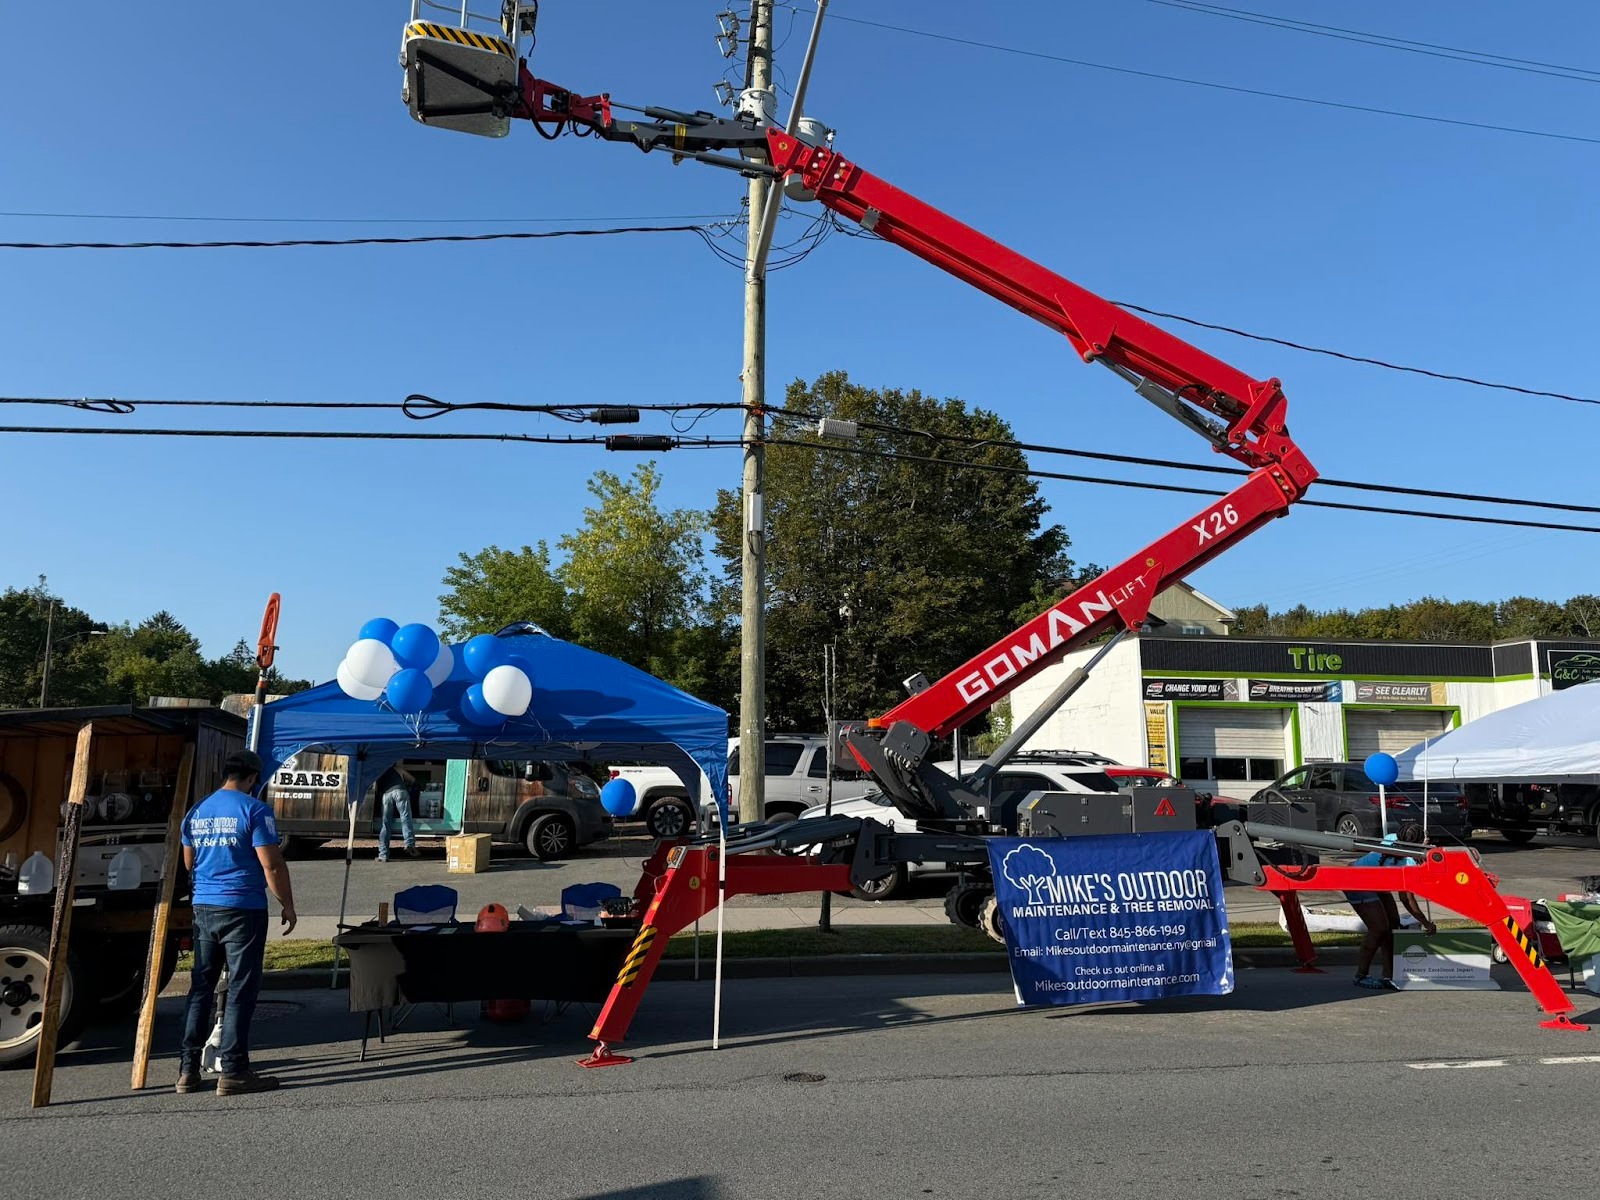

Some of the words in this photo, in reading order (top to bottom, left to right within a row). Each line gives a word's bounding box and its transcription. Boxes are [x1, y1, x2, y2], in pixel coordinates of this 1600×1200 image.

[1192, 503, 1239, 546] X26
[955, 590, 1114, 705] GOMAN
[1110, 575, 1147, 606] LIFT
[1287, 647, 1343, 671] Tire
[1554, 668, 1580, 680] G&C
[1165, 684, 1190, 692] CHANGE
[1191, 684, 1207, 692] YOUR
[1268, 685, 1294, 693] BREATHE
[1375, 686, 1390, 695] SEE
[1392, 686, 1428, 696] CLEARLY!
[280, 772, 340, 787] BARS
[1046, 872, 1115, 904] MIKE'S
[1118, 869, 1209, 901] OUTDOOR
[1013, 903, 1108, 918] MAINTENANCE
[1110, 903, 1120, 914] &
[1122, 901, 1155, 913] TREE
[1157, 899, 1214, 912] REMOVAL
[1055, 926, 1107, 941] Call/Text
[1109, 924, 1186, 939] 845-866-1949
[1014, 946, 1043, 957] Email:
[1046, 937, 1217, 956] Mikesoutdoormaintenance.ny@gmail
[1075, 966, 1100, 976] Check
[1103, 967, 1112, 975] us
[1114, 965, 1128, 974] out
[1130, 964, 1155, 973] online
[1157, 963, 1165, 972] at
[1035, 973, 1199, 991] Mikesoutdoormaintenance.com
